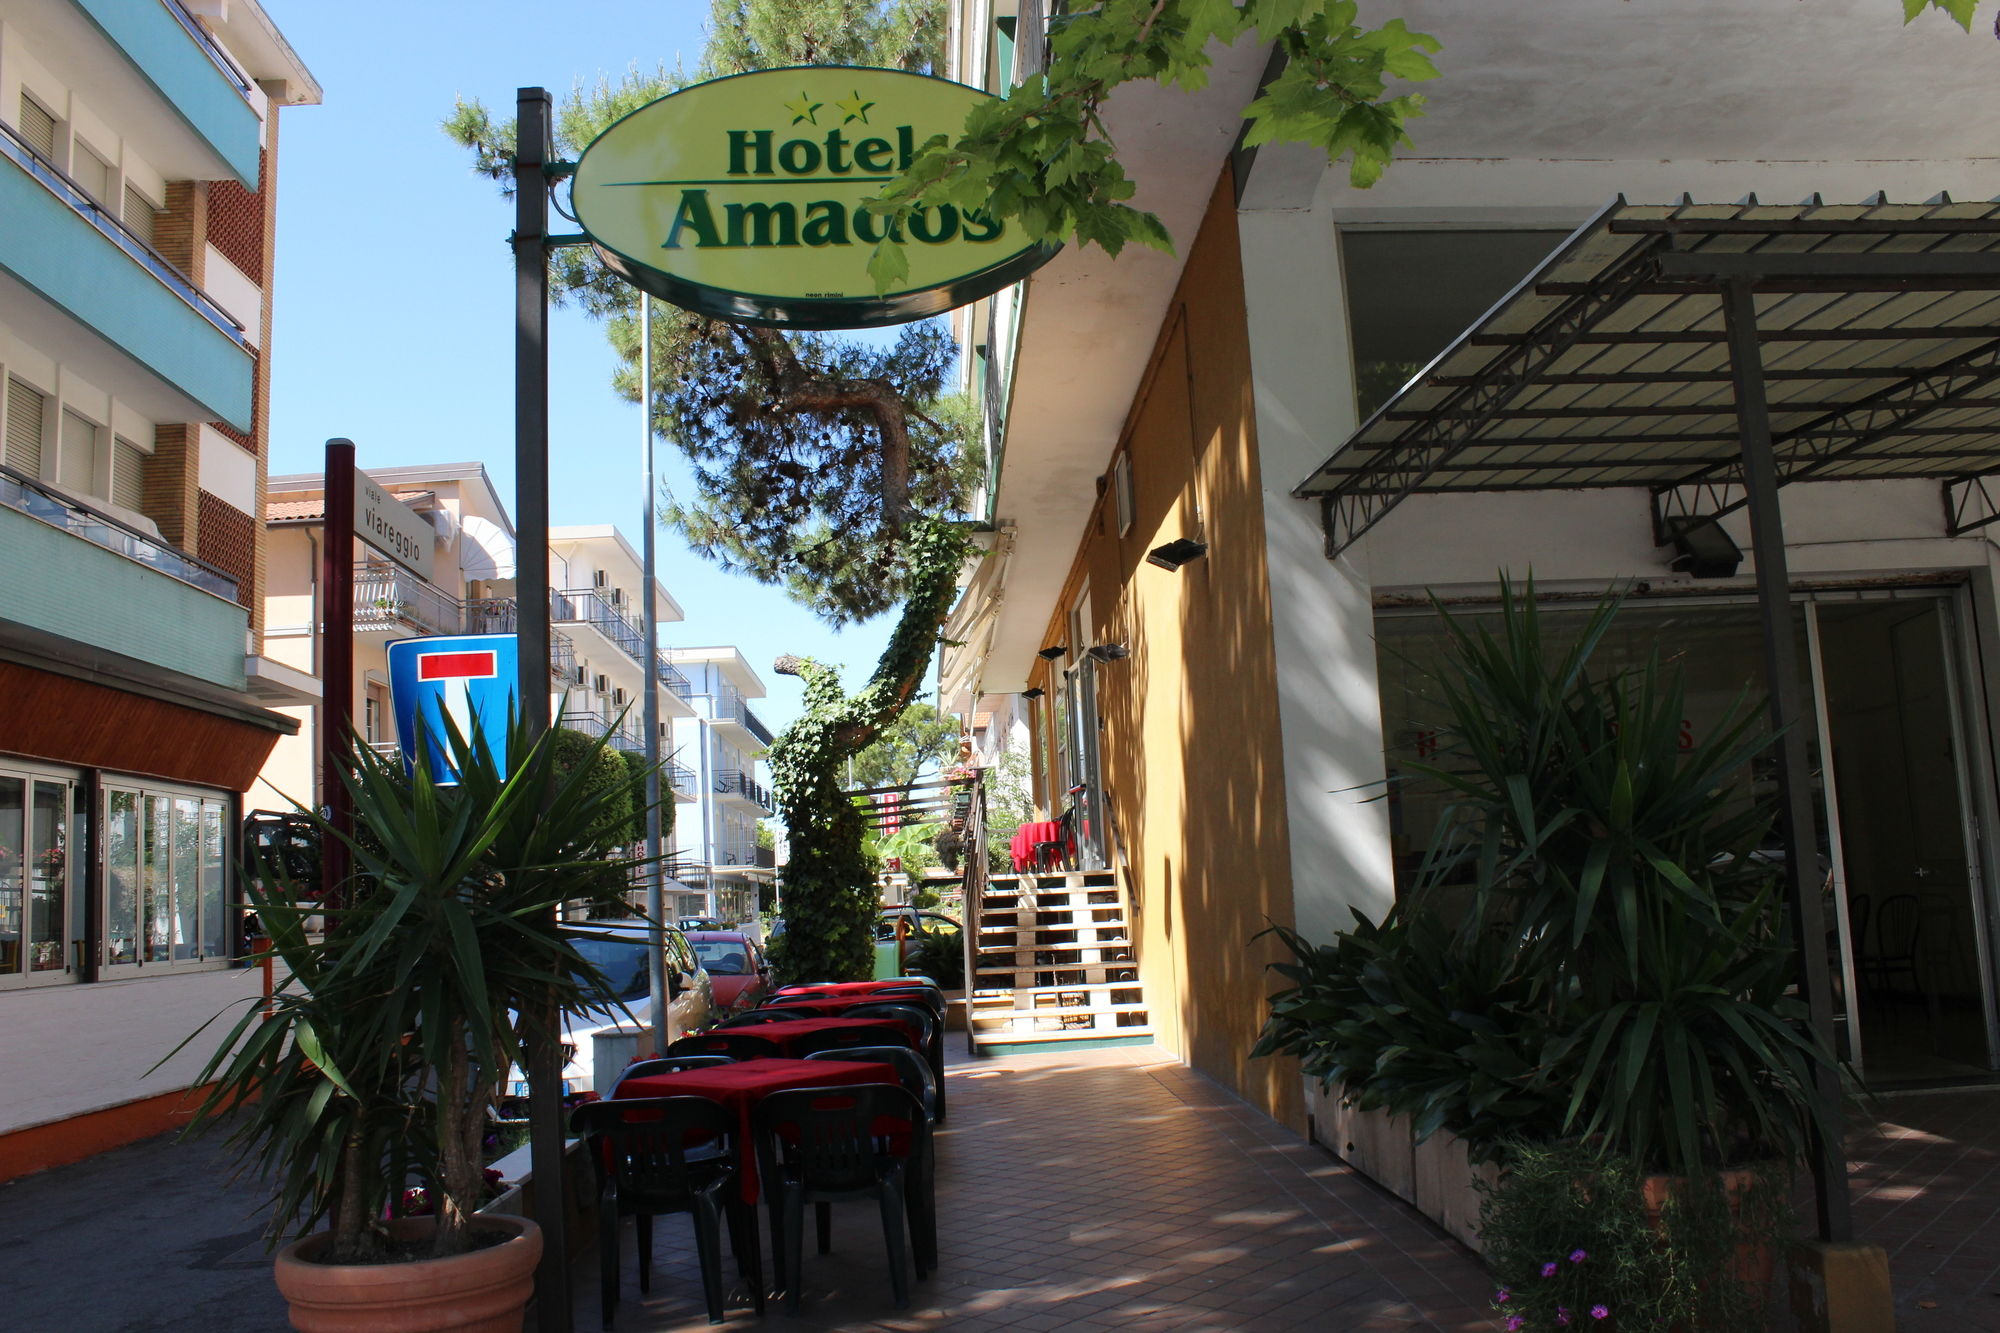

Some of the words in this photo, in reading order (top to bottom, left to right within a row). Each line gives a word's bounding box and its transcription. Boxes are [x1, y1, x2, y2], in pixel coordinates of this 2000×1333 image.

[727, 126, 914, 175] Hotel
[824, 290, 844, 298] rimini
[365, 487, 381, 504] viale
[365, 507, 420, 561] viareggio
[637, 846, 645, 874] HOL
